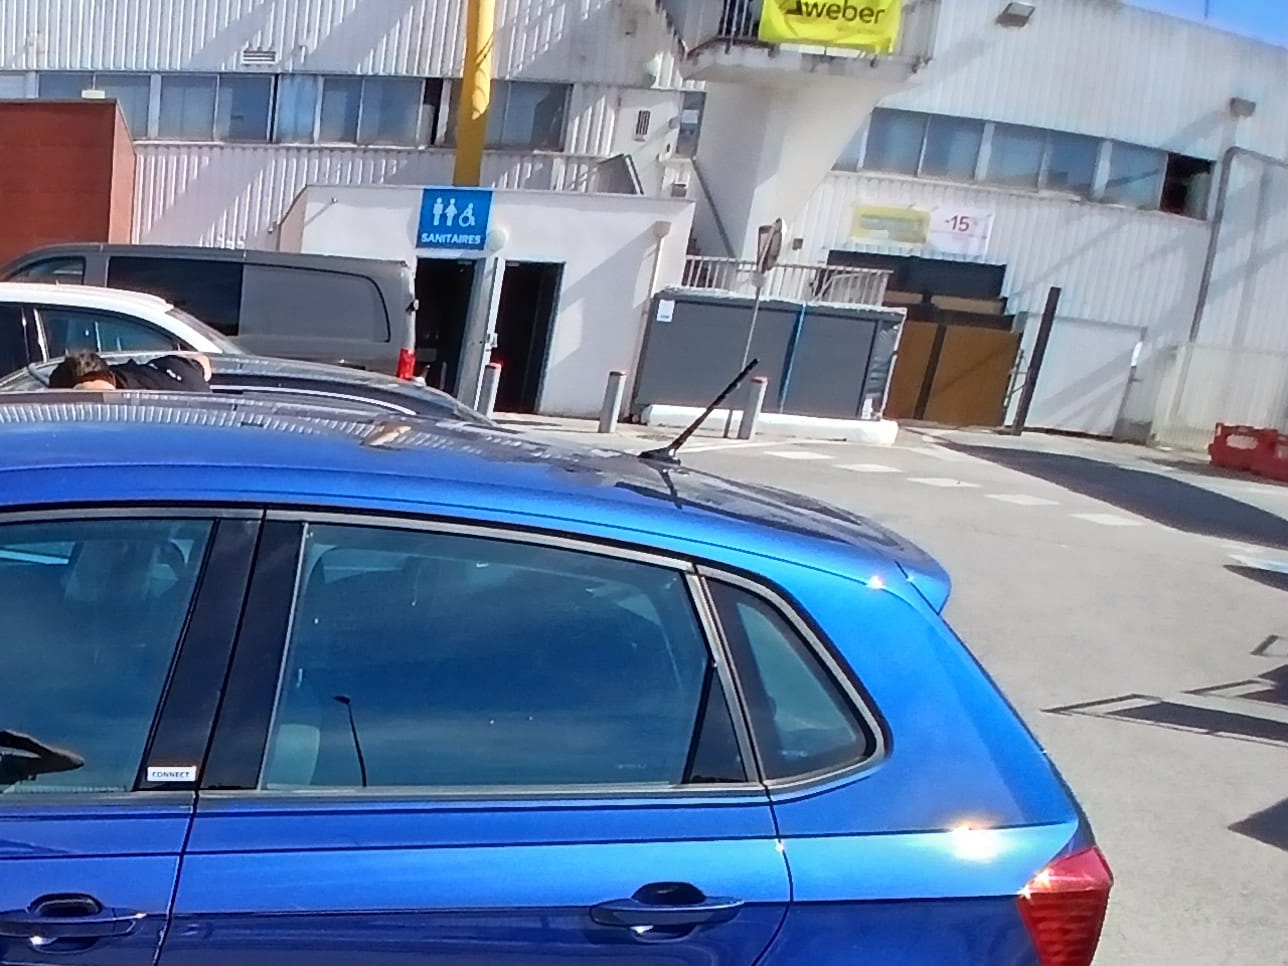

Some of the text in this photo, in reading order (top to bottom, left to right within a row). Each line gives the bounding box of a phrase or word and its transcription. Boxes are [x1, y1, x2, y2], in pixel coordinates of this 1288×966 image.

[804, 0, 885, 24] weber
[420, 233, 481, 245] SANITAIRES
[151, 771, 190, 779] CONNECT
